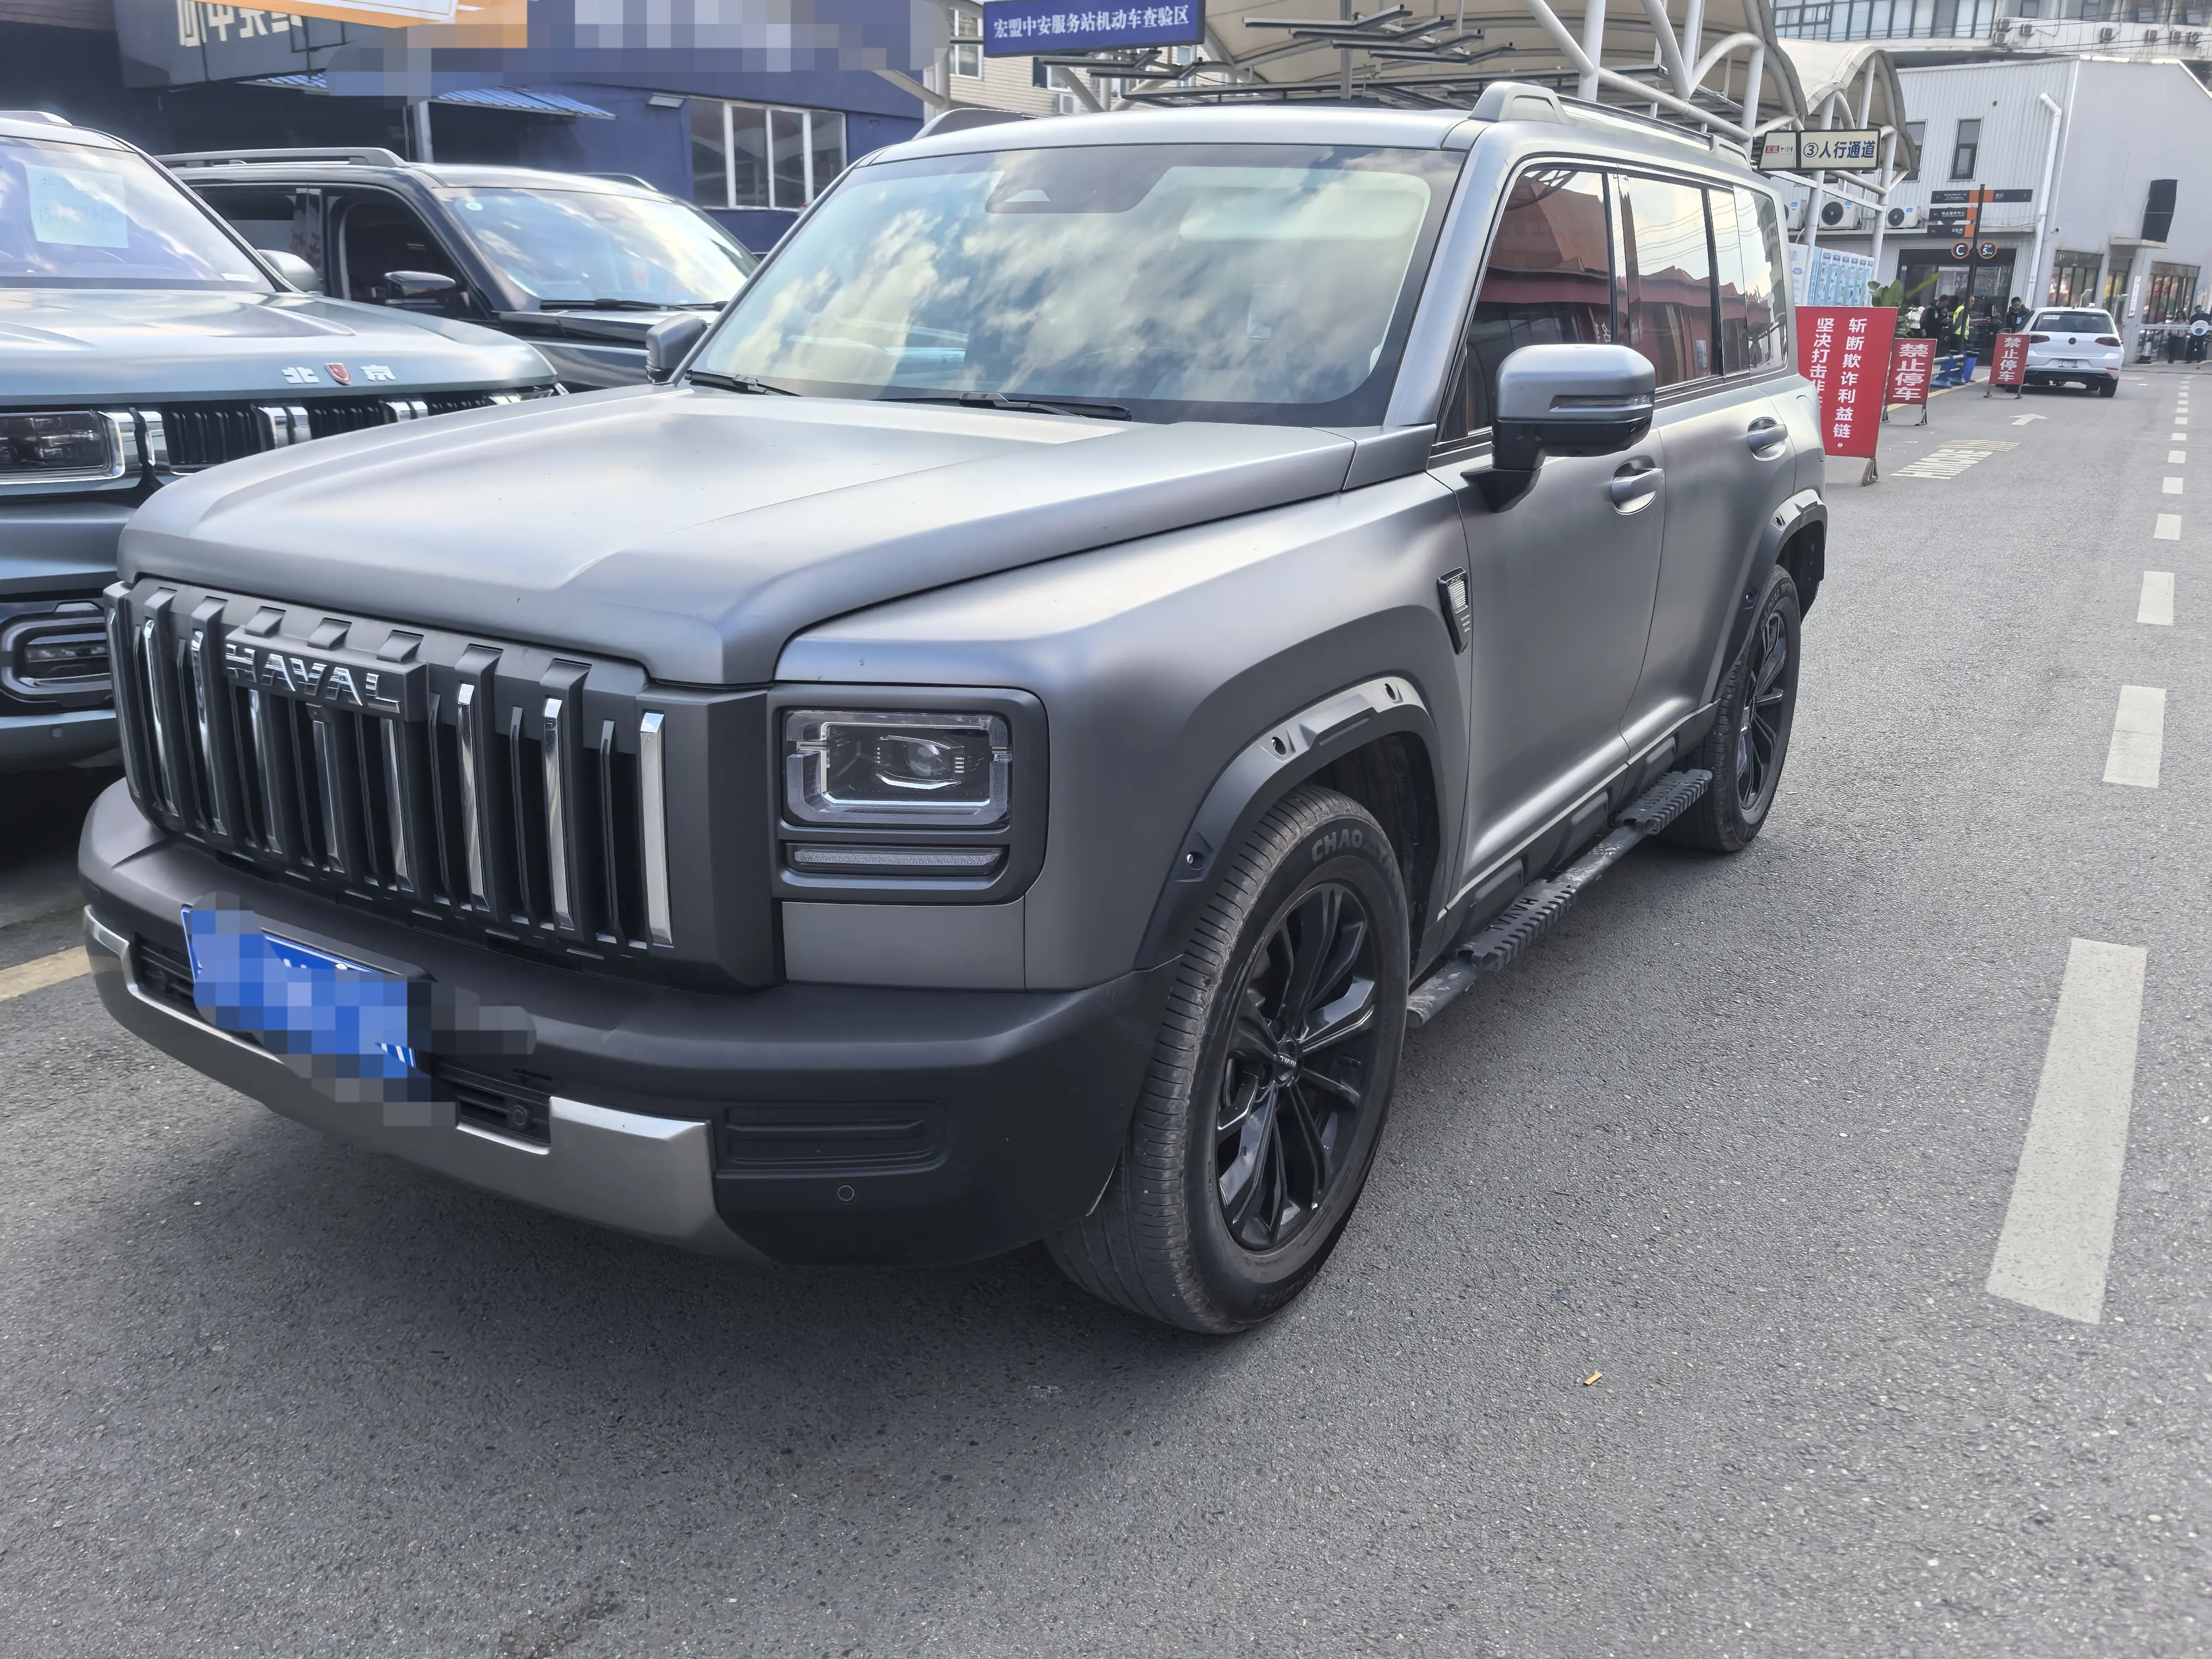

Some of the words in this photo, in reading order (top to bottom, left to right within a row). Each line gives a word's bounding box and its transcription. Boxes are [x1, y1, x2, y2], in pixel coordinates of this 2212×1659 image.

[993, 4, 1190, 38] 宏盟中安服务站机动车查验区
[1956, 245, 1965, 255] C
[281, 364, 397, 385] 北京
[1892, 343, 1929, 401] 禁止停车
[1998, 338, 2022, 382] 禁止停车
[225, 643, 400, 713] HAVAL
